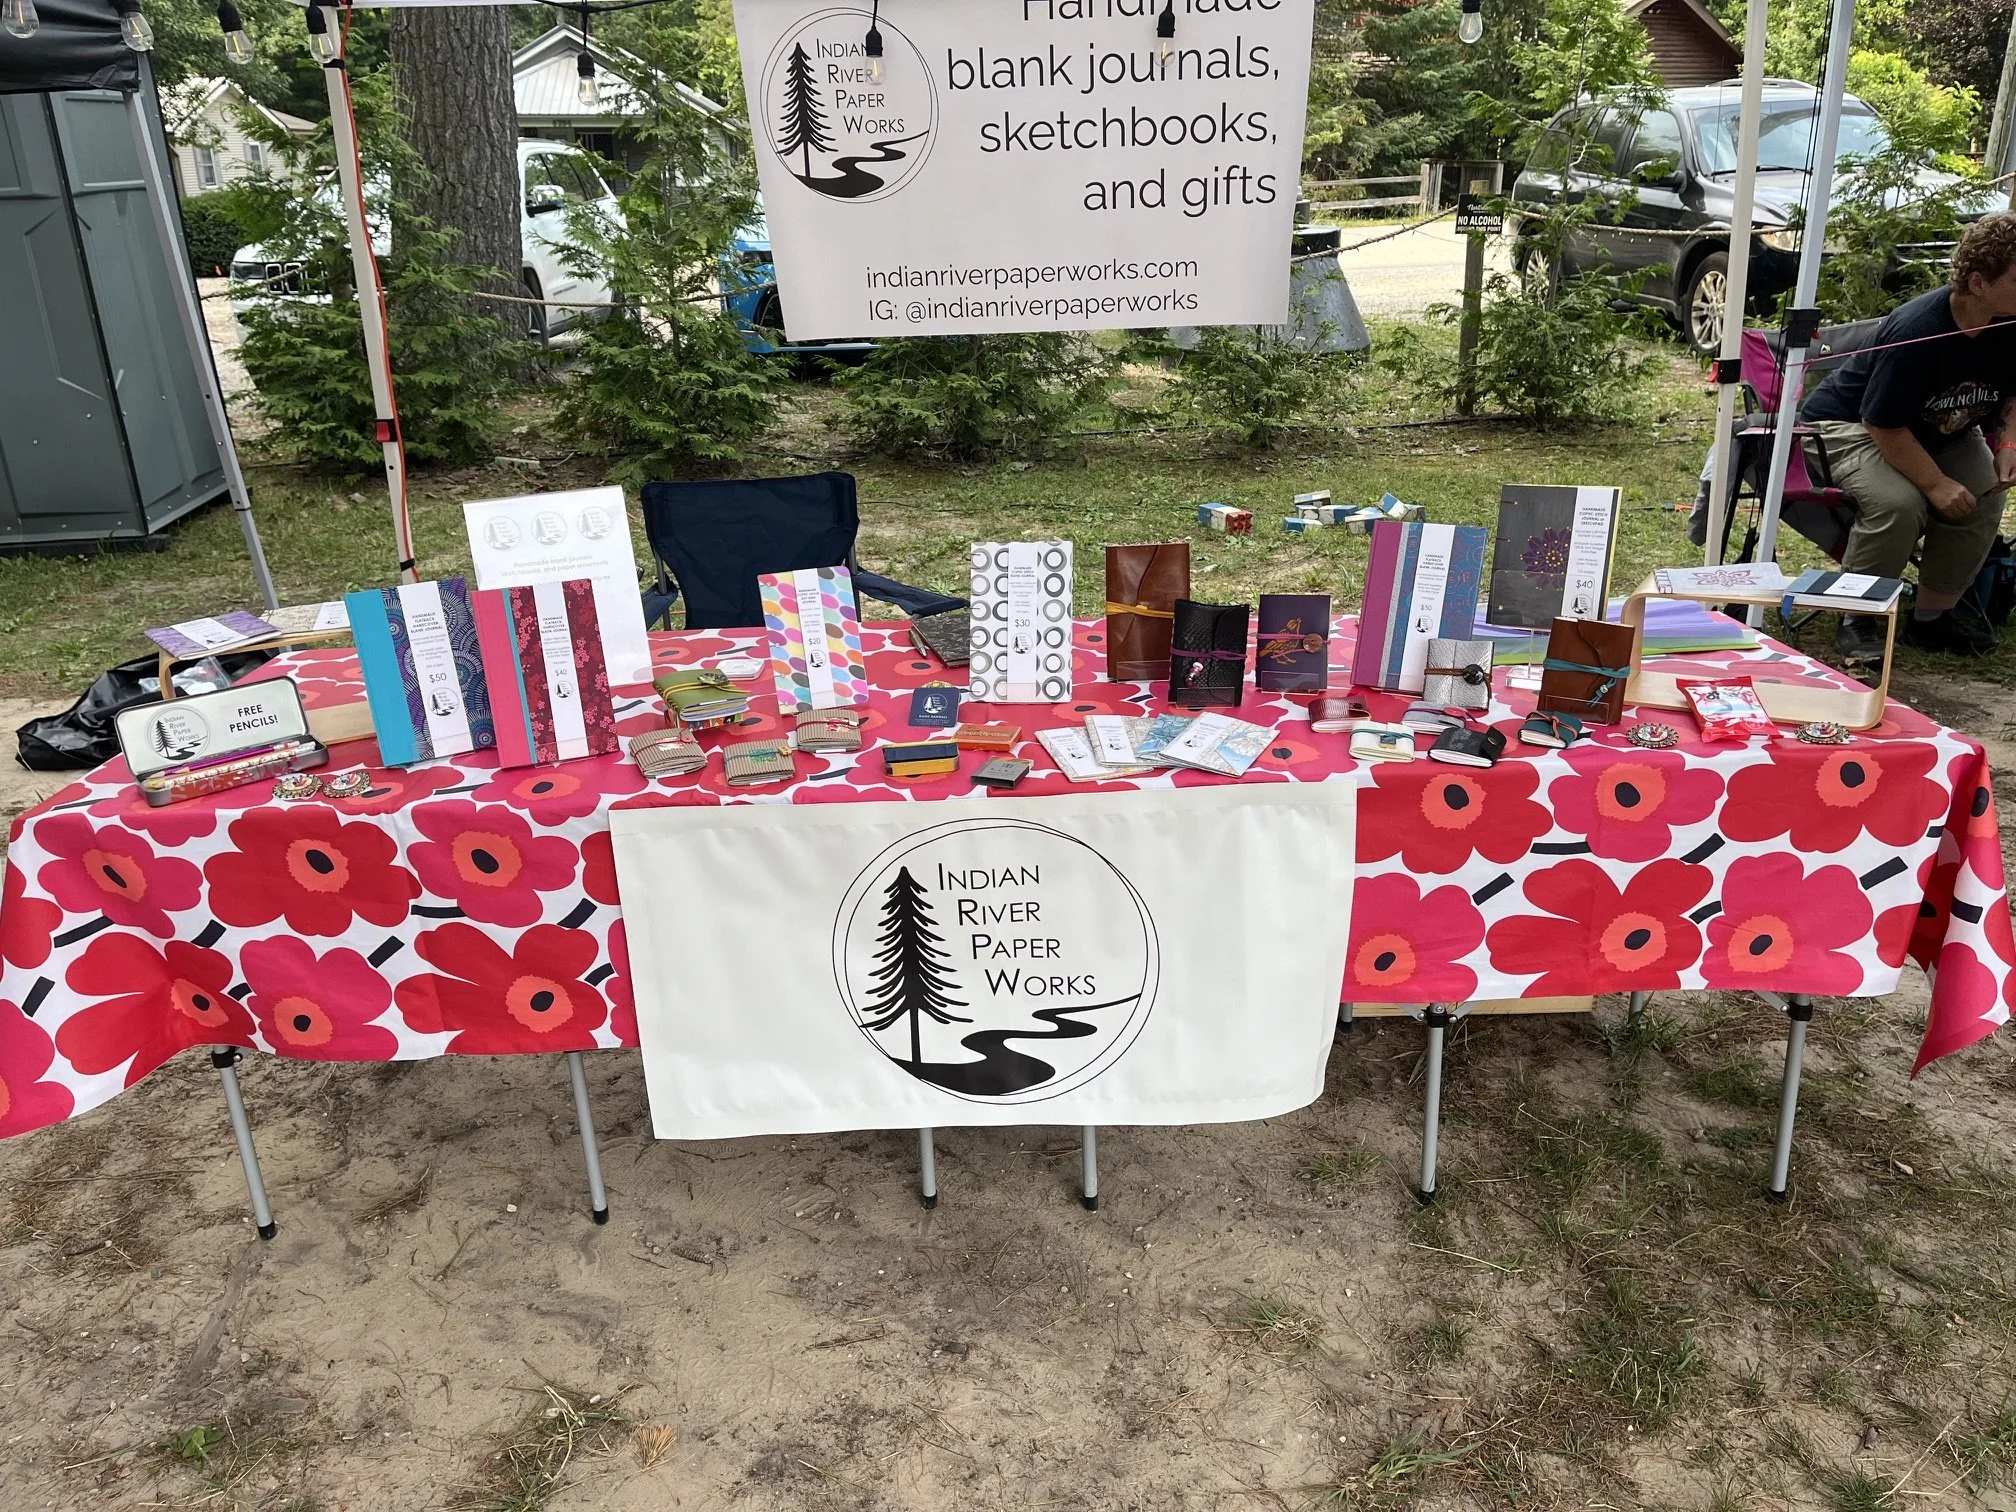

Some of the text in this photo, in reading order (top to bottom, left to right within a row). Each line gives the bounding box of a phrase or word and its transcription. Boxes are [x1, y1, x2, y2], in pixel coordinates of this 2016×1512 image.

[1024, 0, 1282, 20] Hana
[827, 64, 874, 83] RIVER
[947, 35, 1279, 95] blank journals,
[836, 89, 885, 108] PAPER
[843, 114, 905, 134] WORKS
[980, 102, 1278, 153] sketchbooks,
[1083, 165, 1278, 217] and gifts
[1458, 216, 1501, 225] NO ALCOHOL
[867, 258, 1199, 290] indianriverpaperworks.com
[869, 289, 1199, 324] IG: @indianriverpaperworks
[1575, 579, 1593, 589] $40
[1014, 618, 1031, 628] $30
[808, 637, 821, 646] $20
[428, 672, 447, 684] $50
[555, 669, 568, 677] $40
[164, 715, 185, 723] INDIAN
[238, 704, 264, 718] FREE
[169, 721, 186, 730] RIVER
[173, 728, 191, 736] PAPER
[229, 714, 279, 733] PENCILS!
[177, 733, 200, 743] WORKS
[937, 862, 1041, 891] INDIAN
[957, 898, 1041, 927] RIVER
[971, 933, 1062, 961] PAPER
[984, 968, 1096, 997] WORKS
